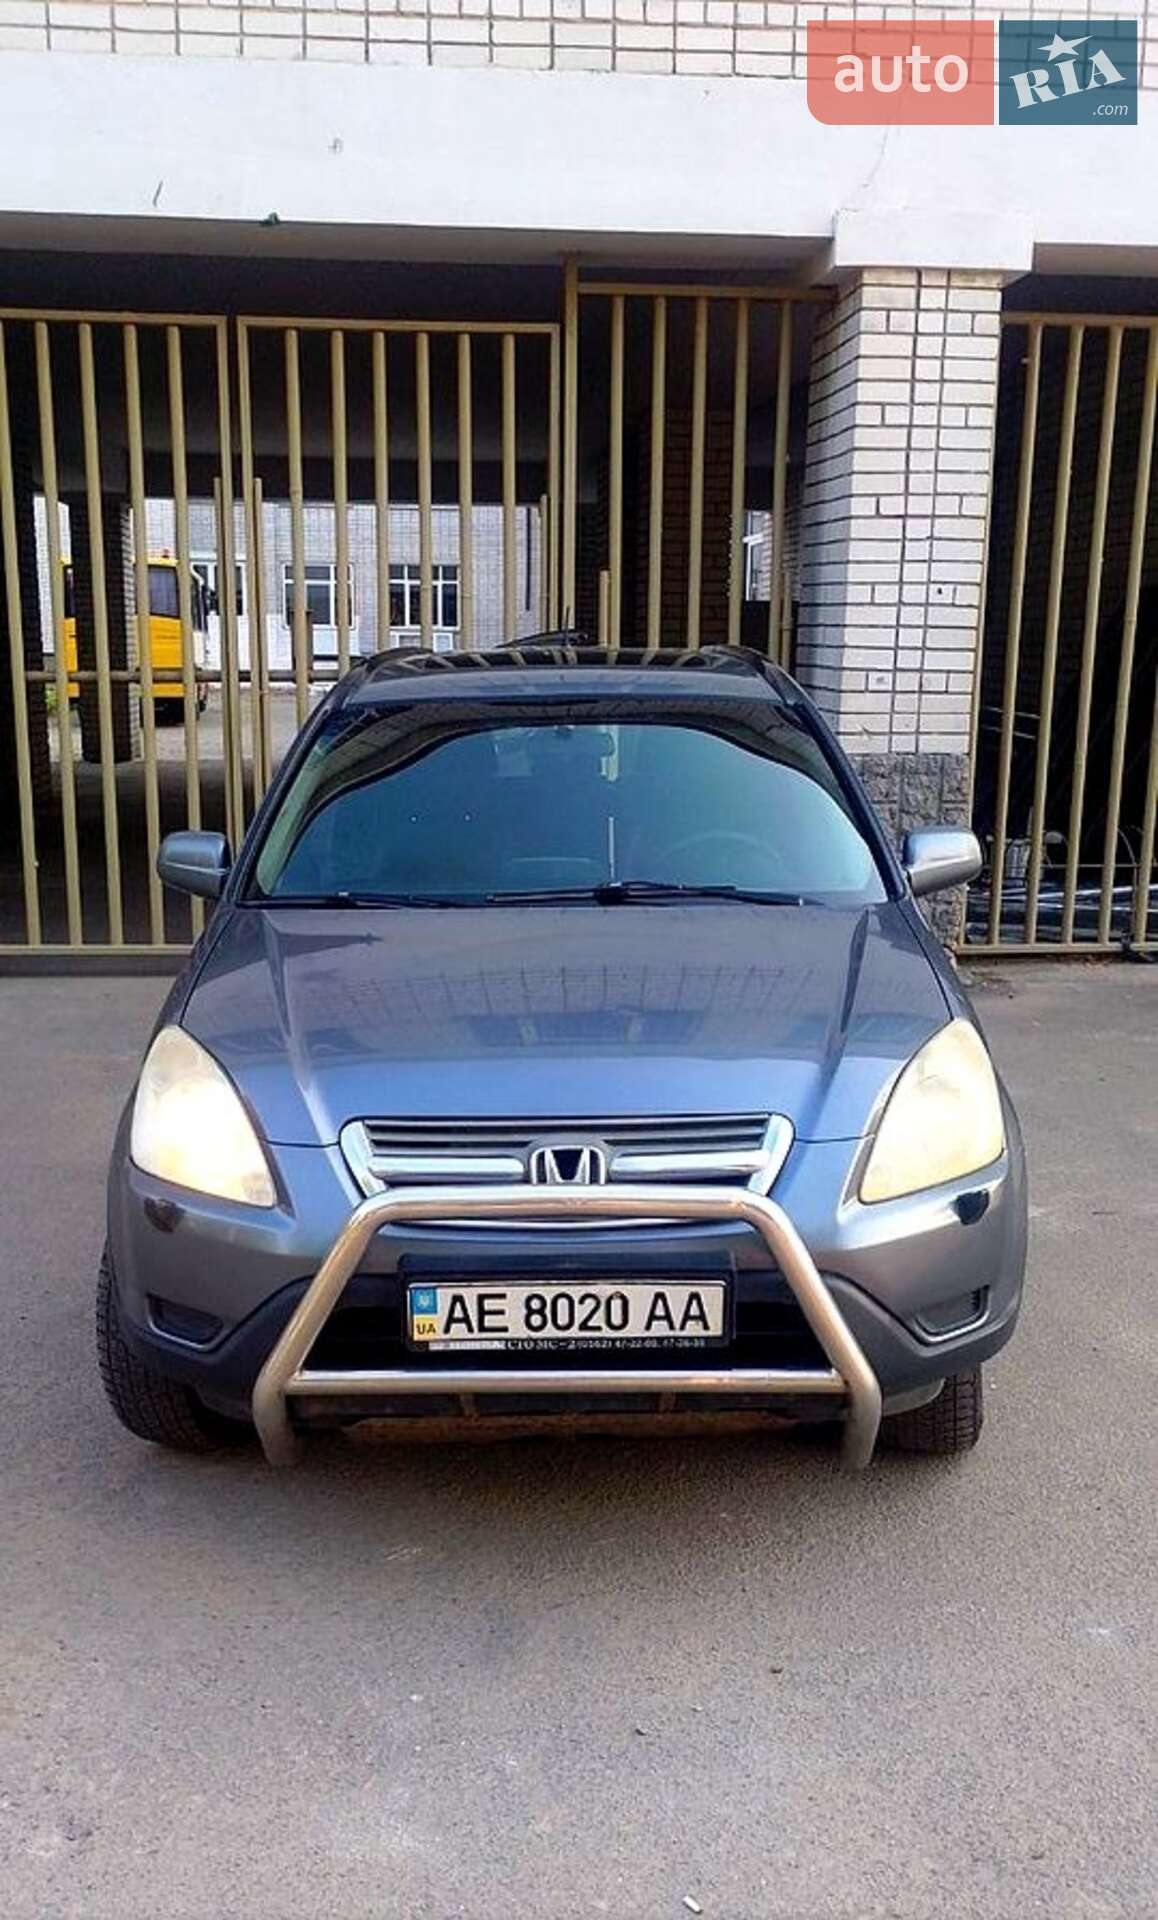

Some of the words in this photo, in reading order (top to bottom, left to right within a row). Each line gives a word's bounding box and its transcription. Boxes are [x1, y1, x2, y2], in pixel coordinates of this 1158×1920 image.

[443, 1293, 509, 1335] AE
[524, 1292, 630, 1333] 8020
[644, 1291, 710, 1332] AA
[416, 1323, 436, 1335] UA
